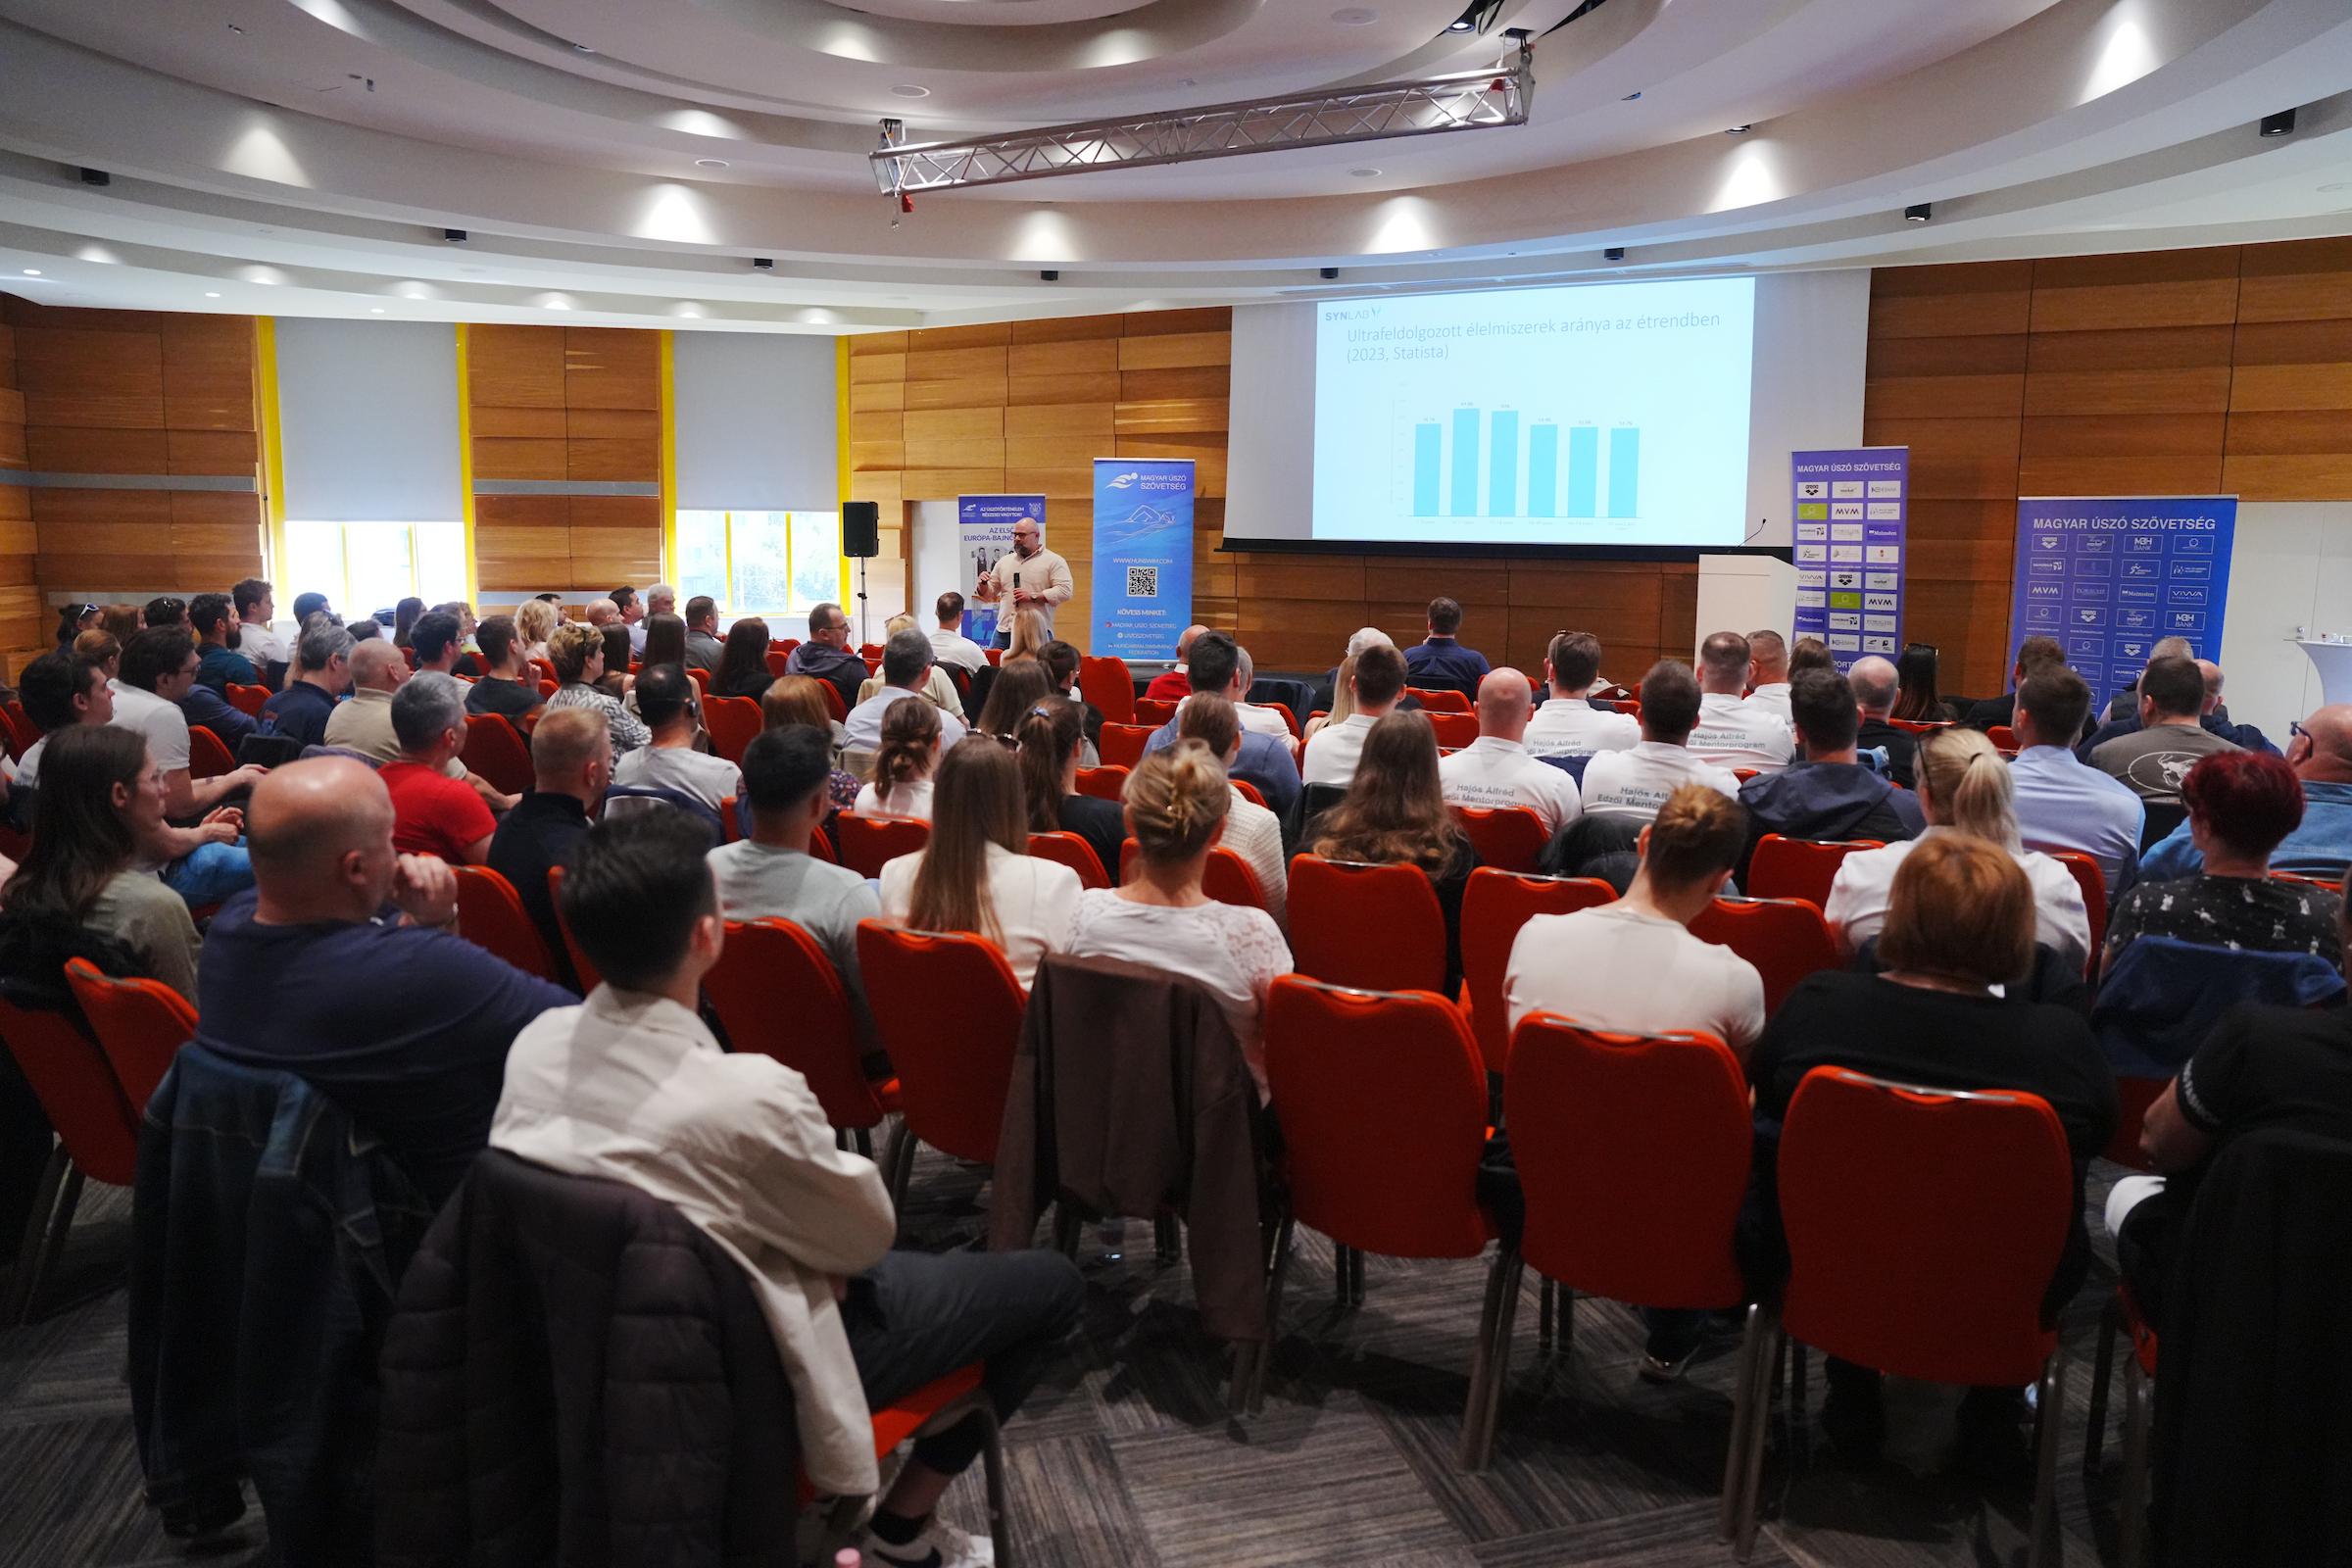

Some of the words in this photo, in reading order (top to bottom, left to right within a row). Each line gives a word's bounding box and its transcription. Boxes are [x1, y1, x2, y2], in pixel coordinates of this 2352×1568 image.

[1325, 310, 1370, 321] SYNLAB
[1347, 325, 1461, 343] Ultrafeldolgozott
[1466, 318, 1556, 337] élelmiszerek
[1560, 318, 1611, 334] aránya
[1616, 318, 1632, 330] az
[1637, 312, 1720, 329] étrendben
[1347, 347, 1390, 364] (2023,
[1394, 344, 1449, 362] Statista)
[1831, 463, 1852, 472] ÚSZÓ
[1853, 462, 1901, 472] SZÖVETSÉG
[1140, 482, 1186, 490] SZÖVETSÉG
[2033, 518, 2088, 529] MAGYAR
[2092, 516, 2128, 530] ÚSZÓ
[2131, 516, 2216, 530] SZÖVETSÉG
[1699, 740, 1765, 749] Mentorprogram
[1457, 784, 1483, 793] Hajós
[1485, 786, 1515, 797] Alfréd
[1620, 786, 1649, 798] Hajós
[1653, 791, 1669, 801] Alf
[1597, 794, 1622, 805] Edzői
[1625, 798, 1660, 810] Mento
